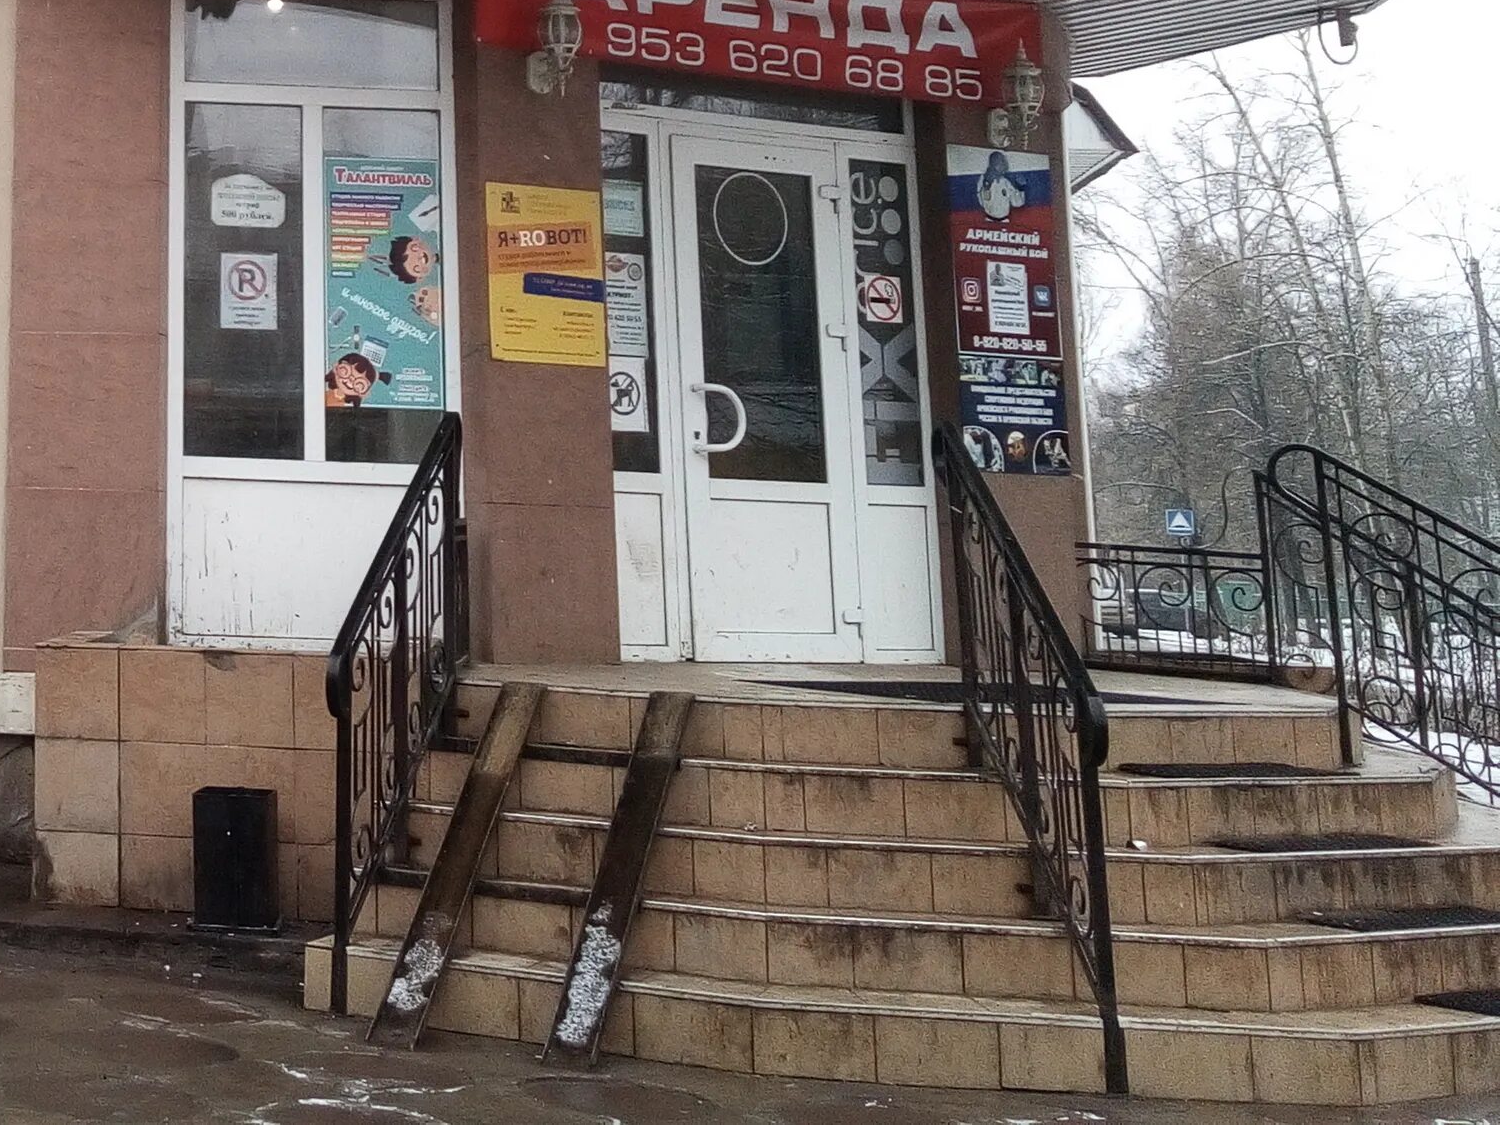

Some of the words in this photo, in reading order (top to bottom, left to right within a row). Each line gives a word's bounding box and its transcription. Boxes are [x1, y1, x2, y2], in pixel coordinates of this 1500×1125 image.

[607, 23, 705, 67] 953
[729, 40, 823, 81] 620
[845, 54, 903, 92] 68
[925, 66, 983, 101] 85
[965, 228, 1041, 245] АРМЕЙСКИЙ
[959, 242, 1028, 257] РУКОПАШНЫЙ
[1028, 247, 1049, 259] БОЙ
